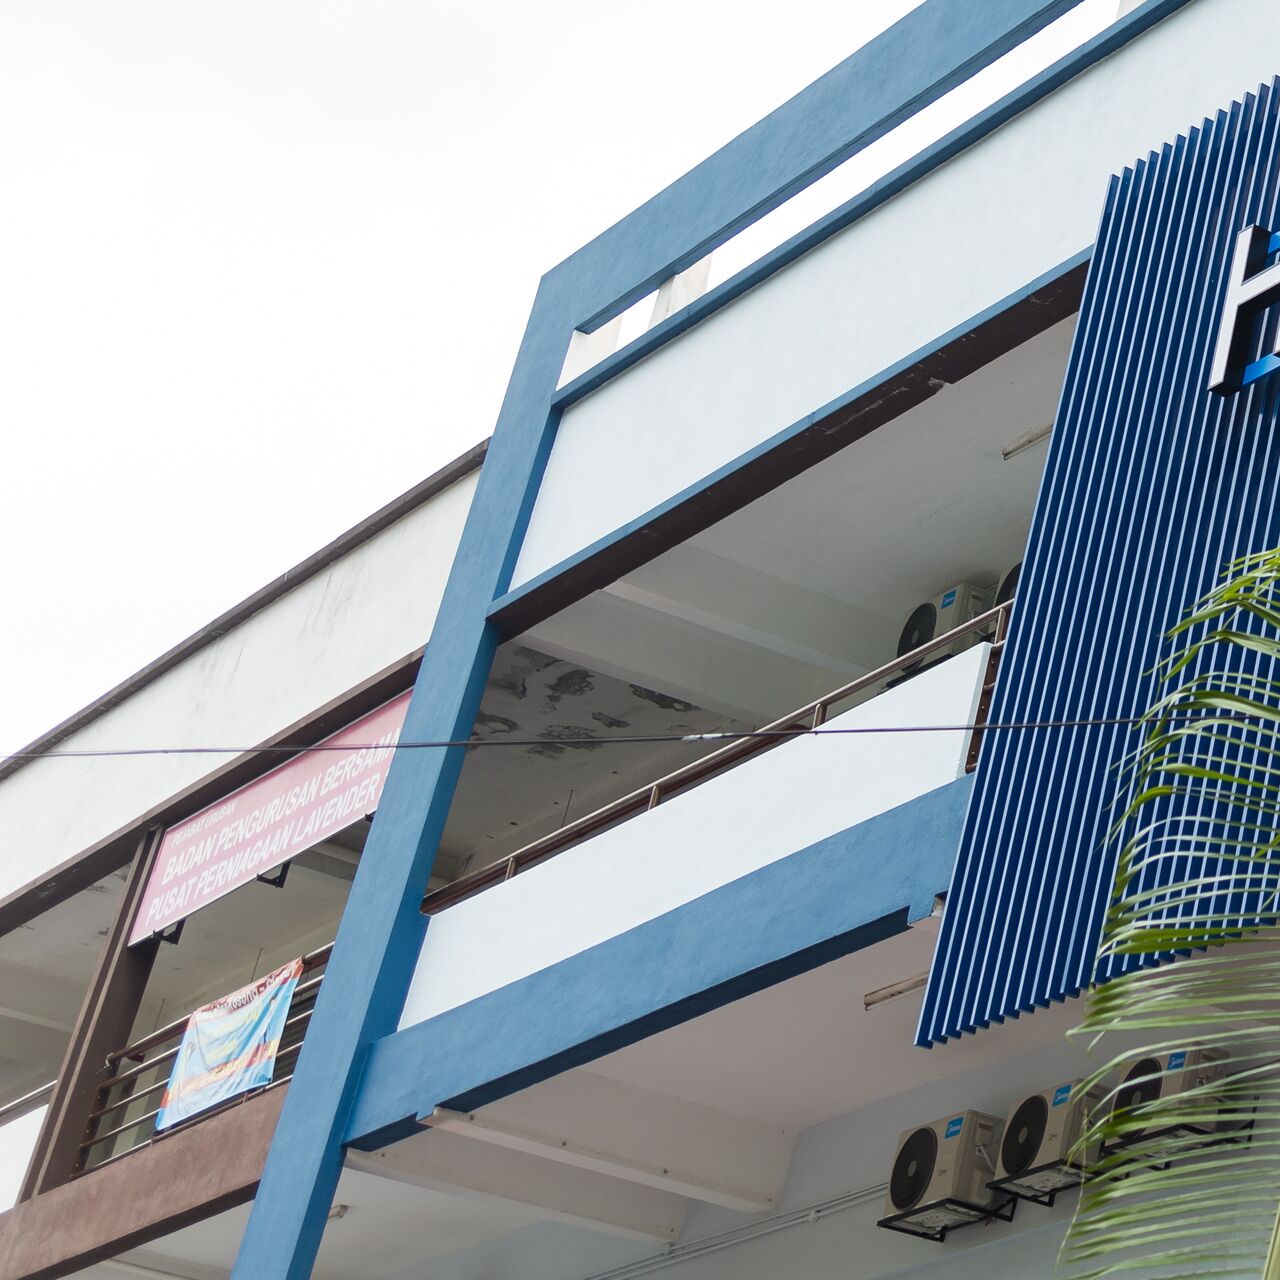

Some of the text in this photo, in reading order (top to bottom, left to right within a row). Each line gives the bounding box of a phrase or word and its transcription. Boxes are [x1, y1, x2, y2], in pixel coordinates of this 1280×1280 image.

[144, 772, 381, 928] PUSAT PERNIAGAAN LAVENDER
[161, 833, 217, 886] BADAN
[214, 772, 322, 856] PENGURUSAN
